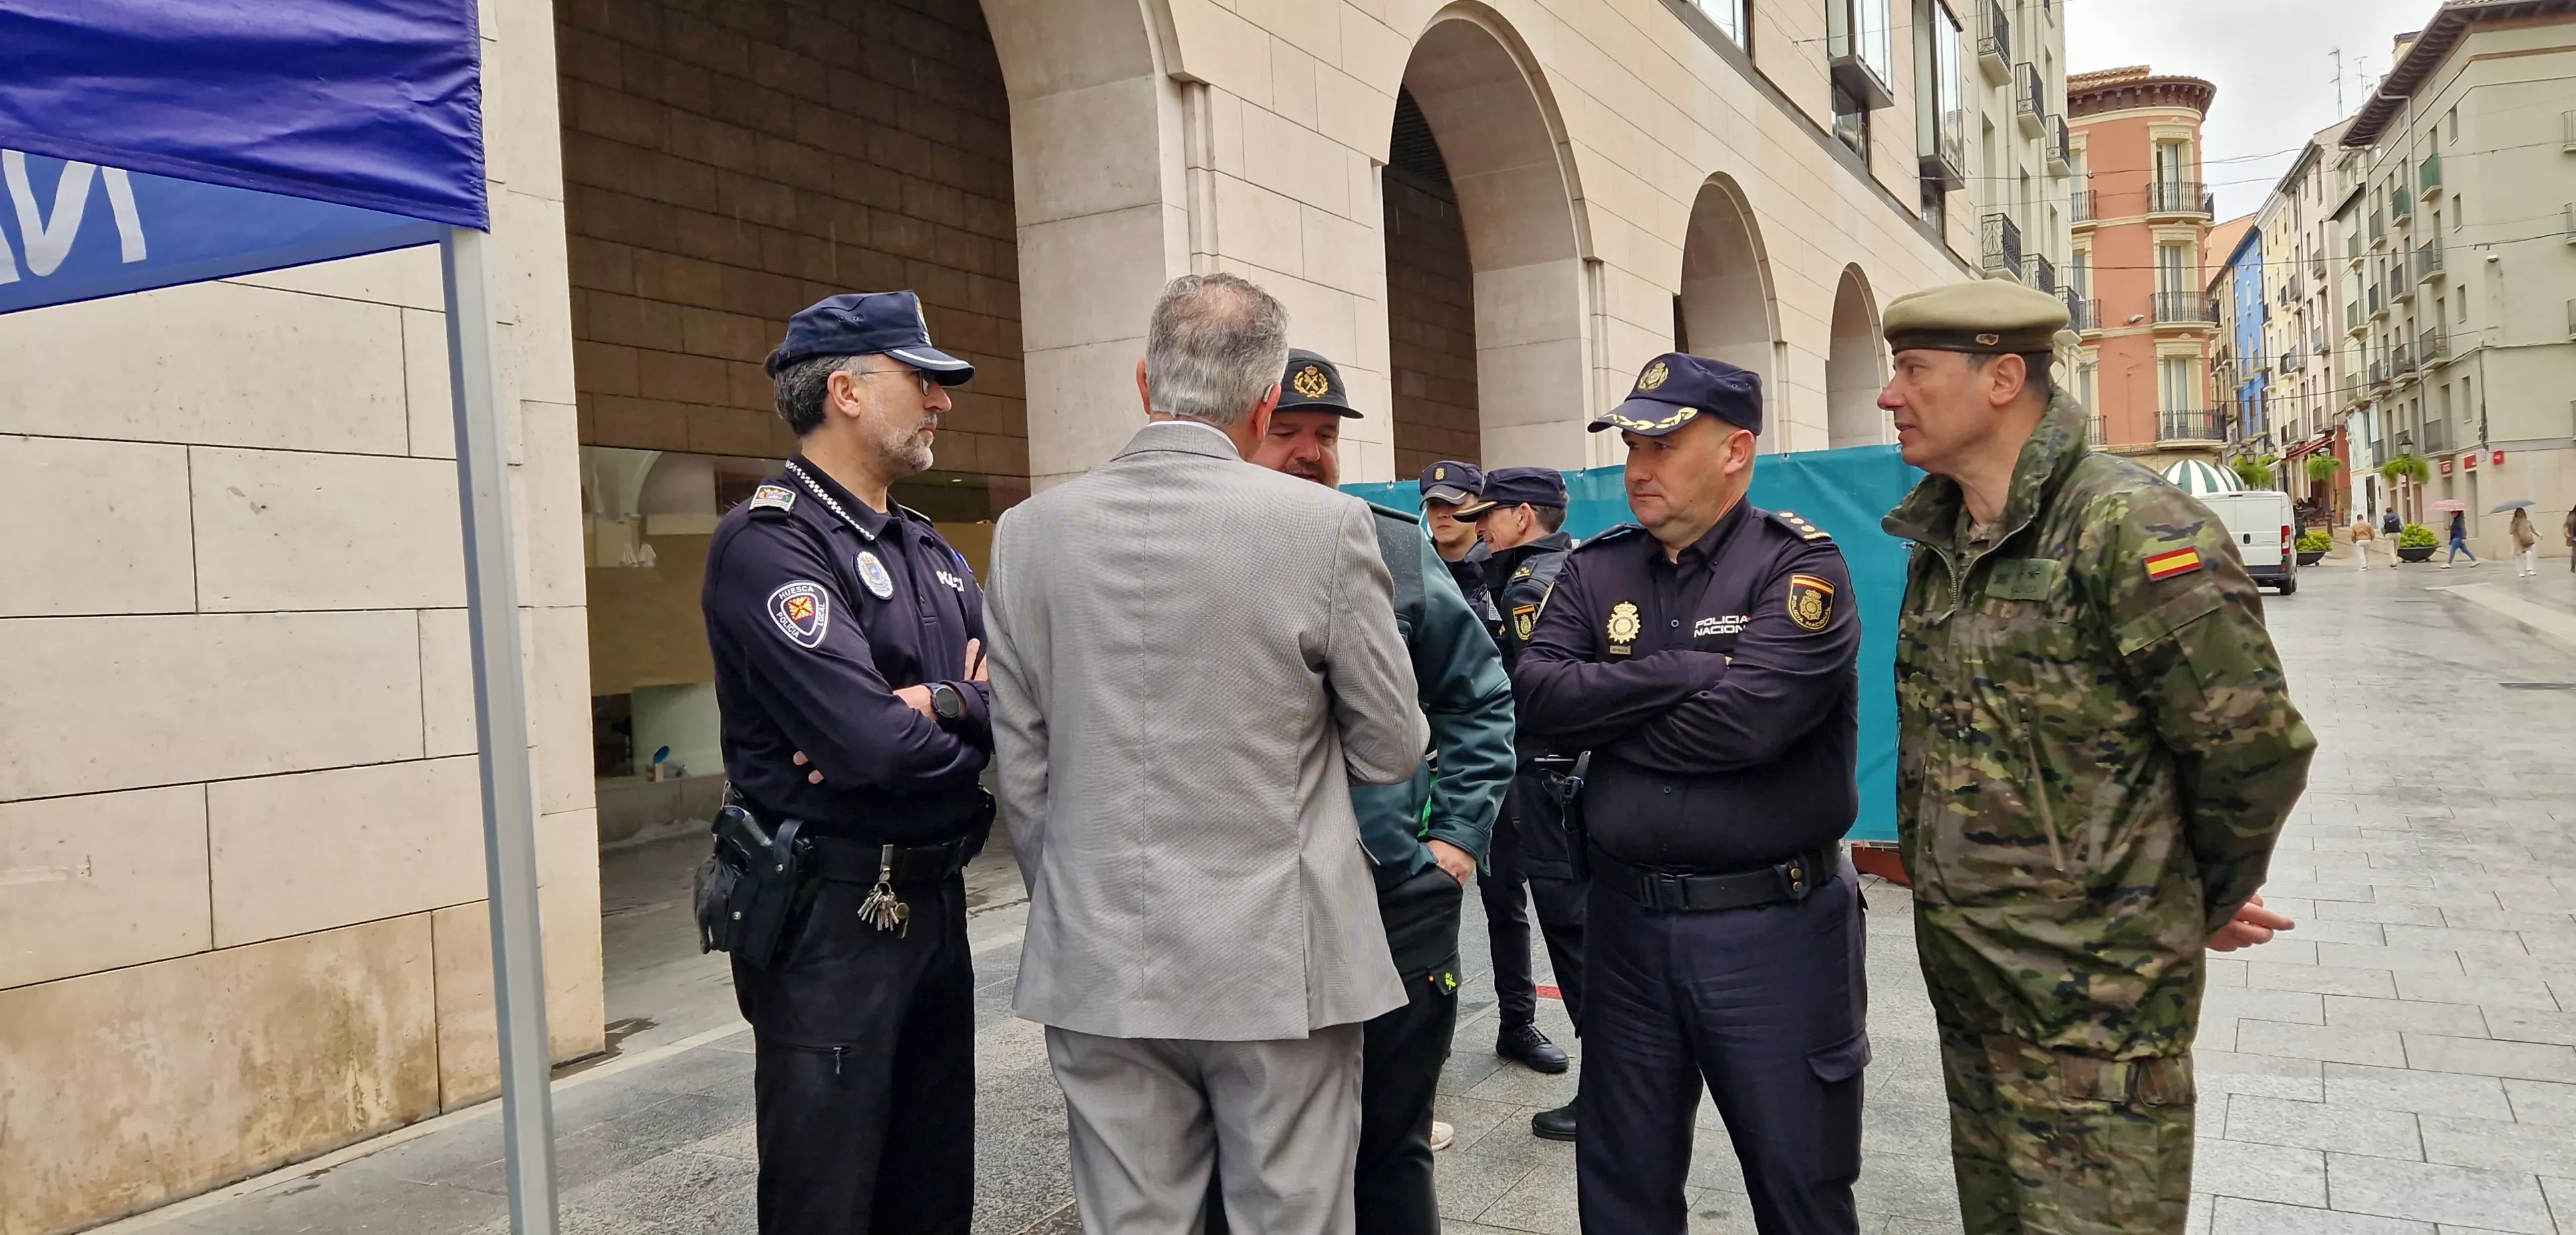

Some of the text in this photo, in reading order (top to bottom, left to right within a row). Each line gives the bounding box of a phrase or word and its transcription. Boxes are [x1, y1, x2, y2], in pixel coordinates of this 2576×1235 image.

[778, 585, 814, 599] HUESCA
[1791, 595, 1803, 622] POLICIA
[776, 603, 825, 638] POLICIA LOCAL
[1694, 615, 1749, 629] POLICIA
